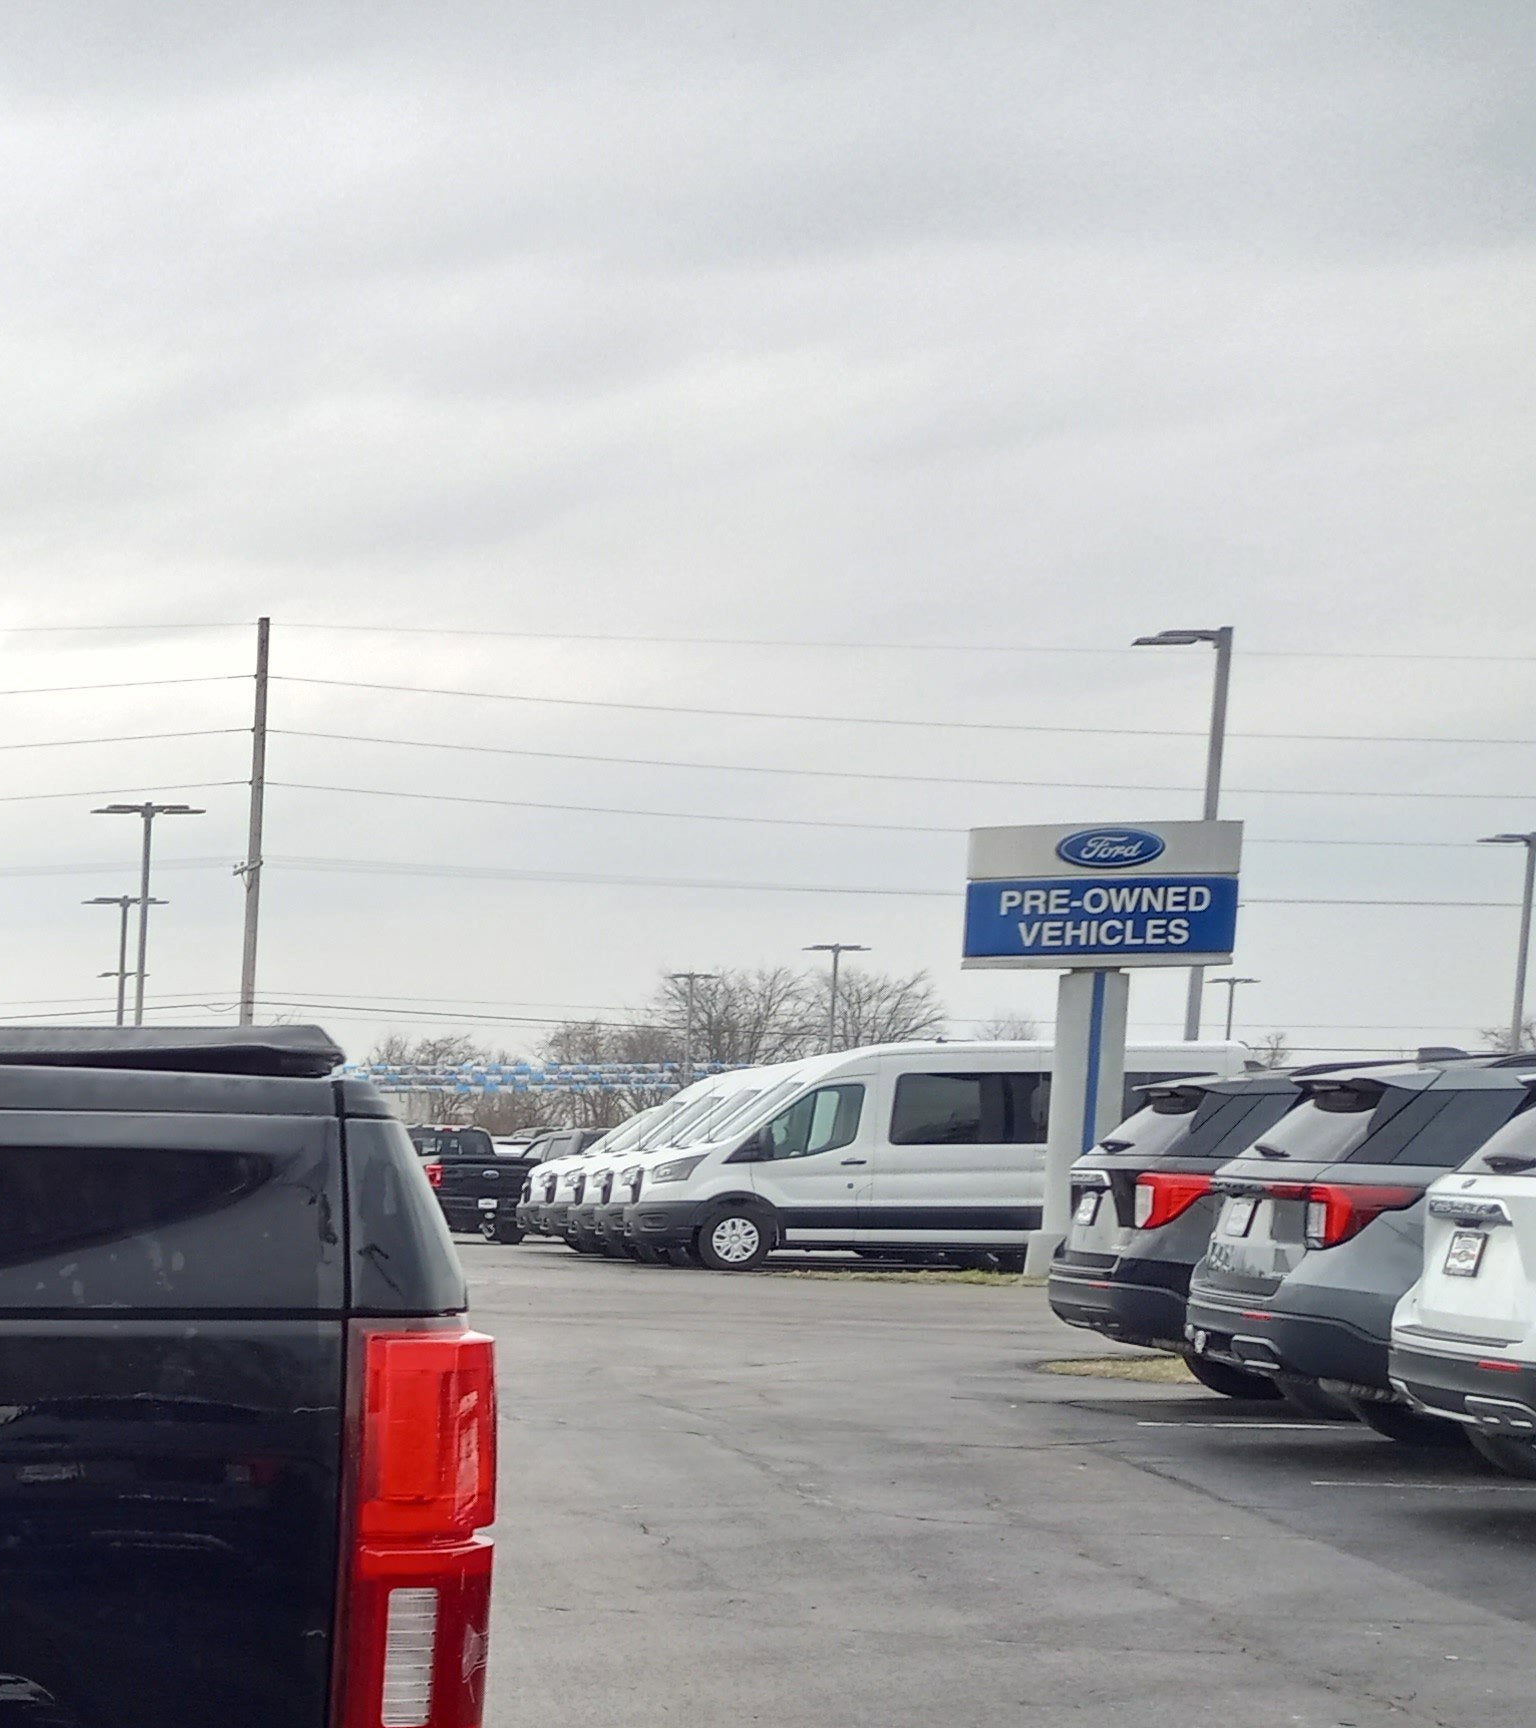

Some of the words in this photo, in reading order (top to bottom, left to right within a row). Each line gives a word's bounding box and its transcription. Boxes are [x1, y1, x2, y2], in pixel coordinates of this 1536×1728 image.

[1081, 837, 1143, 858] Ford
[999, 886, 1211, 916] PRE-OWNED
[1017, 919, 1191, 948] VEHICLES
